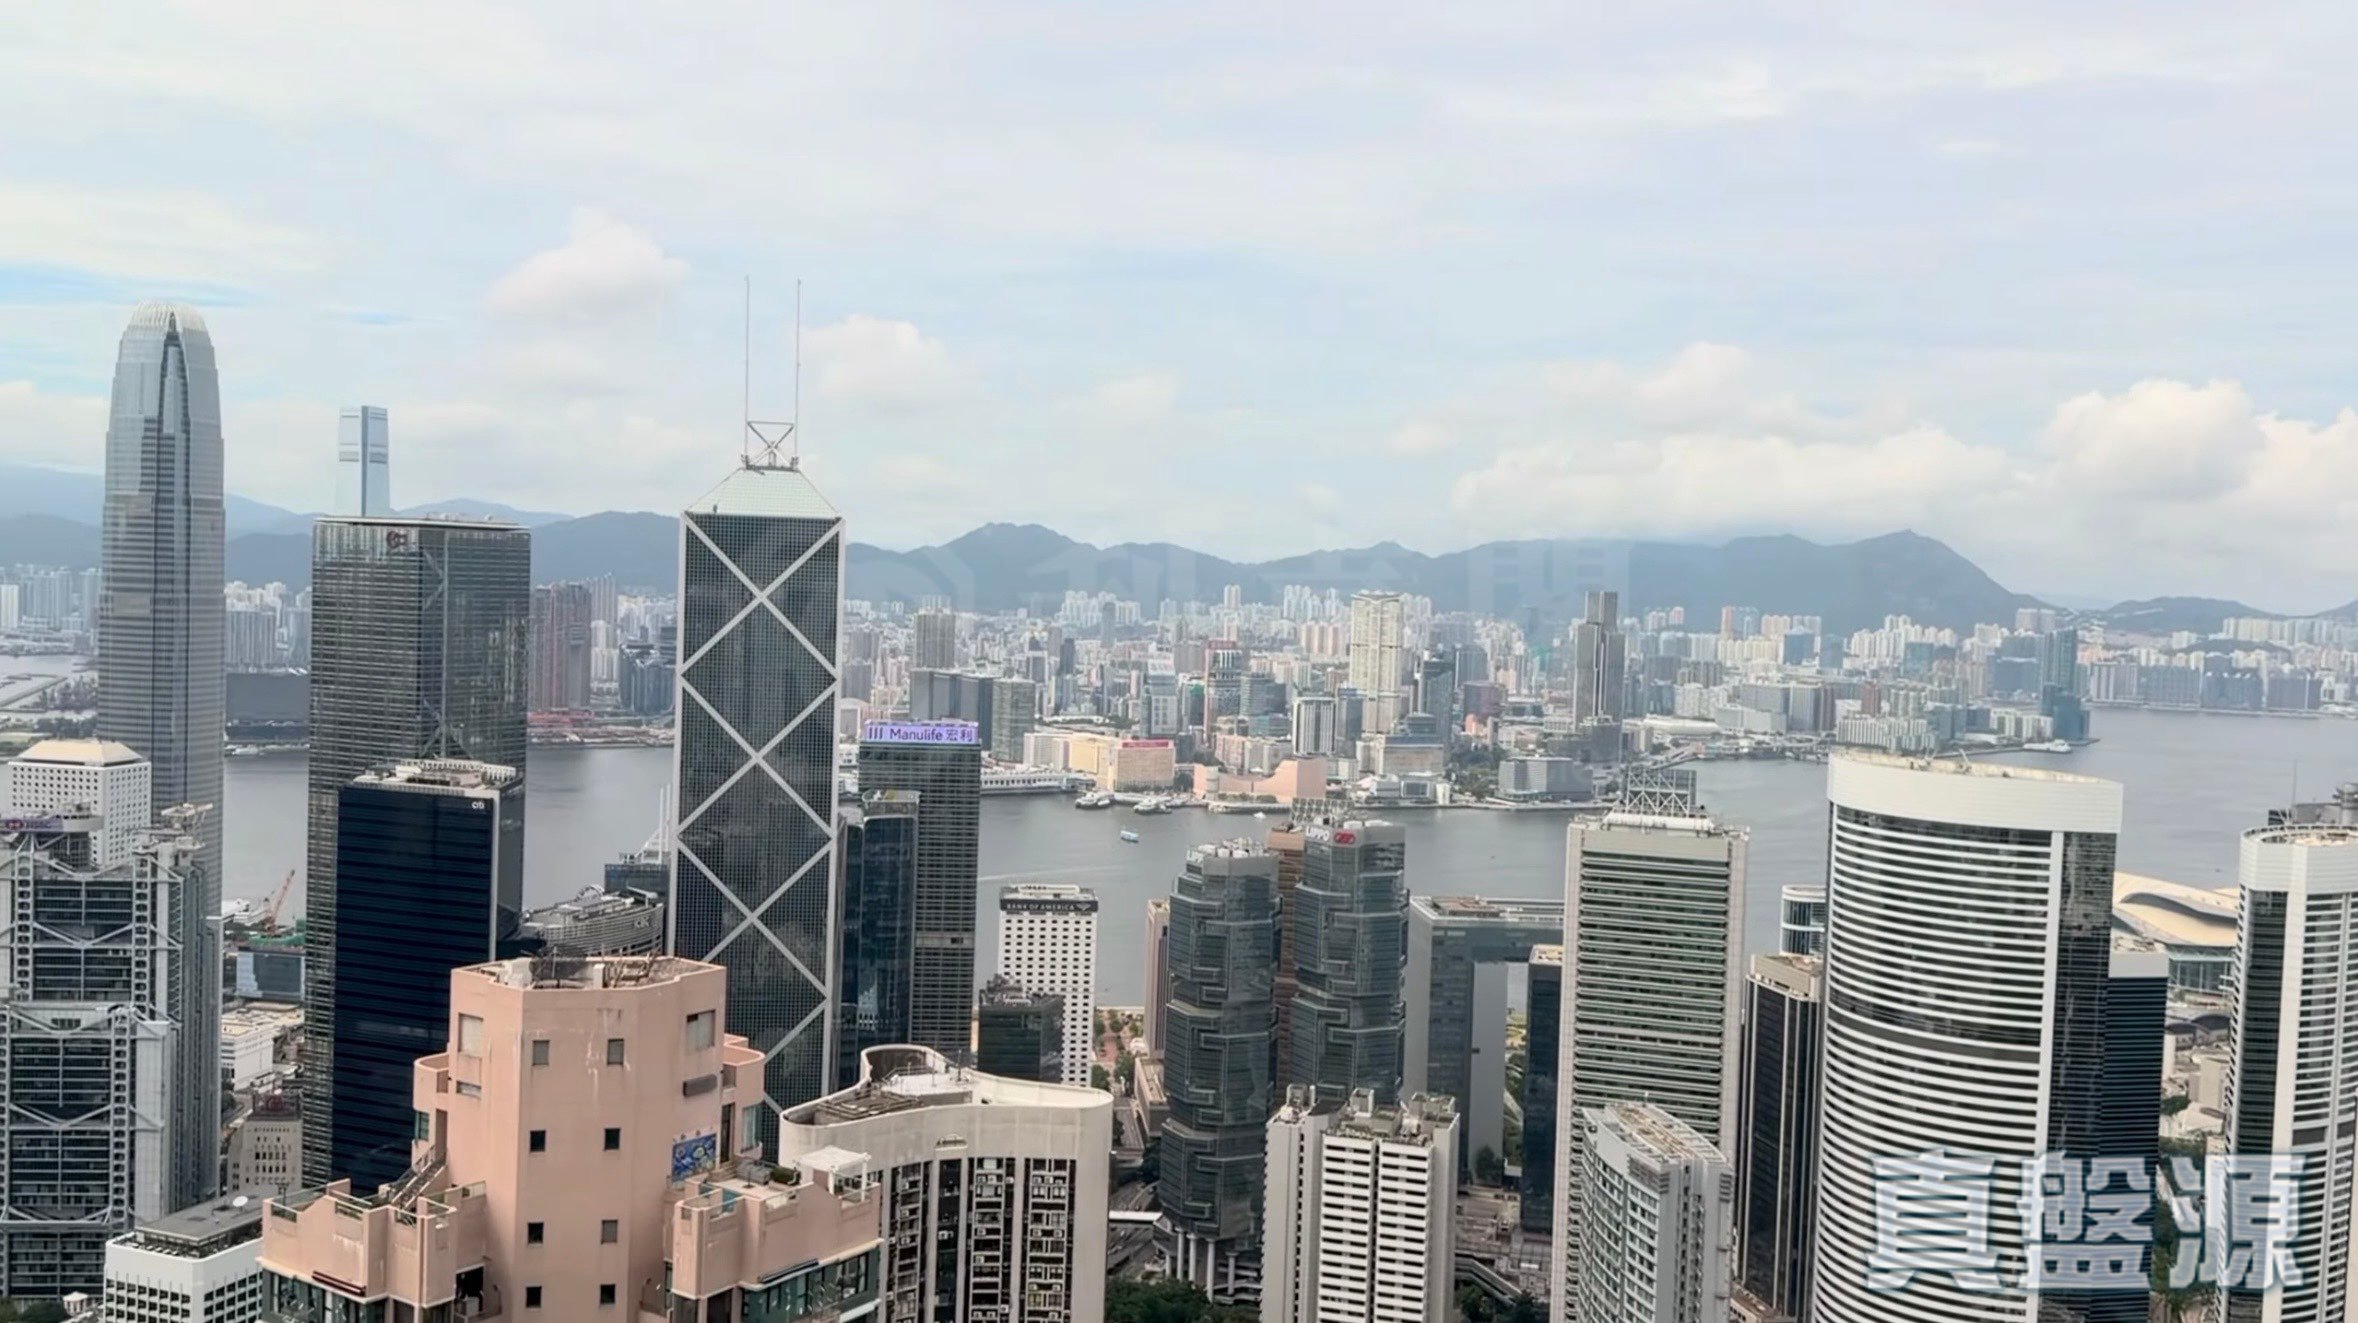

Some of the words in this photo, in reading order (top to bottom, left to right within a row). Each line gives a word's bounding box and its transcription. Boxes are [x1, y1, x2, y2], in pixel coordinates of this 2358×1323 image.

[889, 728, 944, 741] Manulife
[946, 729, 974, 742] 宏利
[1040, 903, 1075, 911] AMERICA
